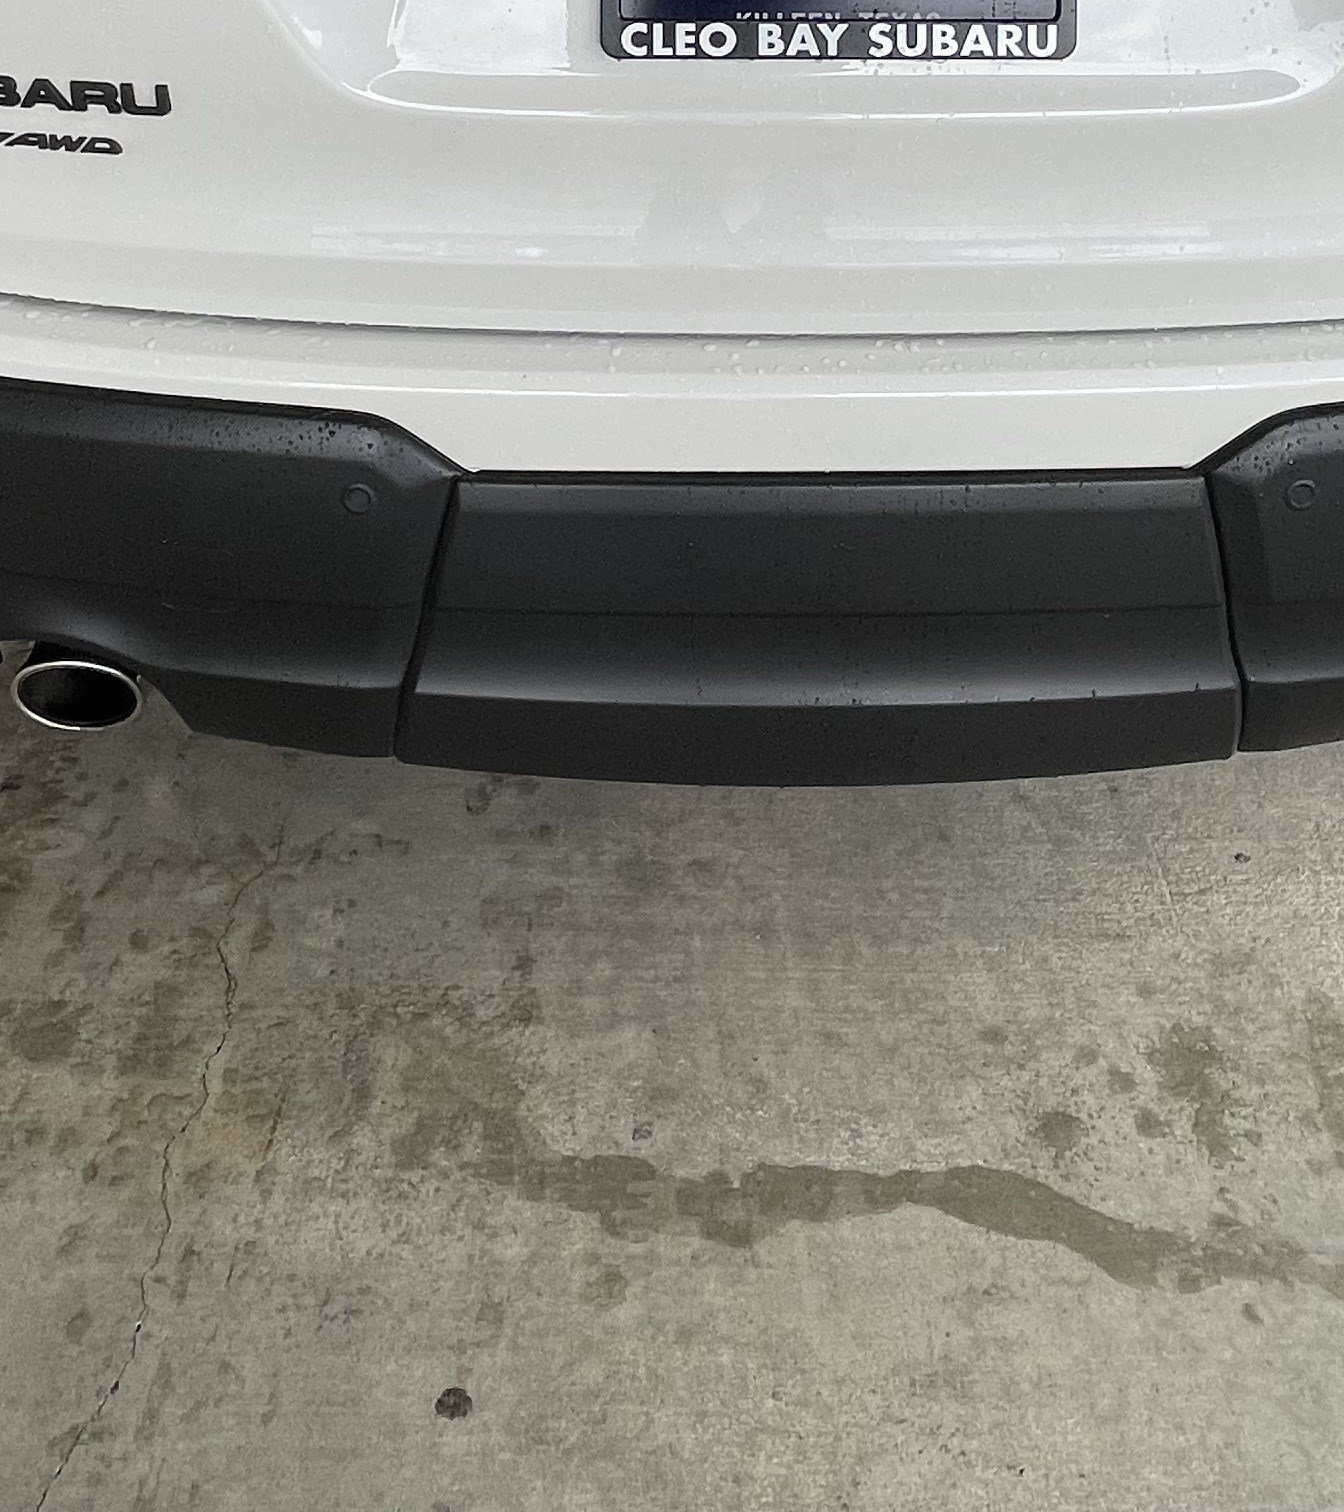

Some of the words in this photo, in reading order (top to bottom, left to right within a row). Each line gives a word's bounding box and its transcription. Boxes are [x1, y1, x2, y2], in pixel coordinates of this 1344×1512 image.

[620, 23, 737, 57] CLEO
[757, 23, 849, 56] BAY
[868, 23, 1058, 58] SUBARU
[4, 132, 123, 154] AWD
